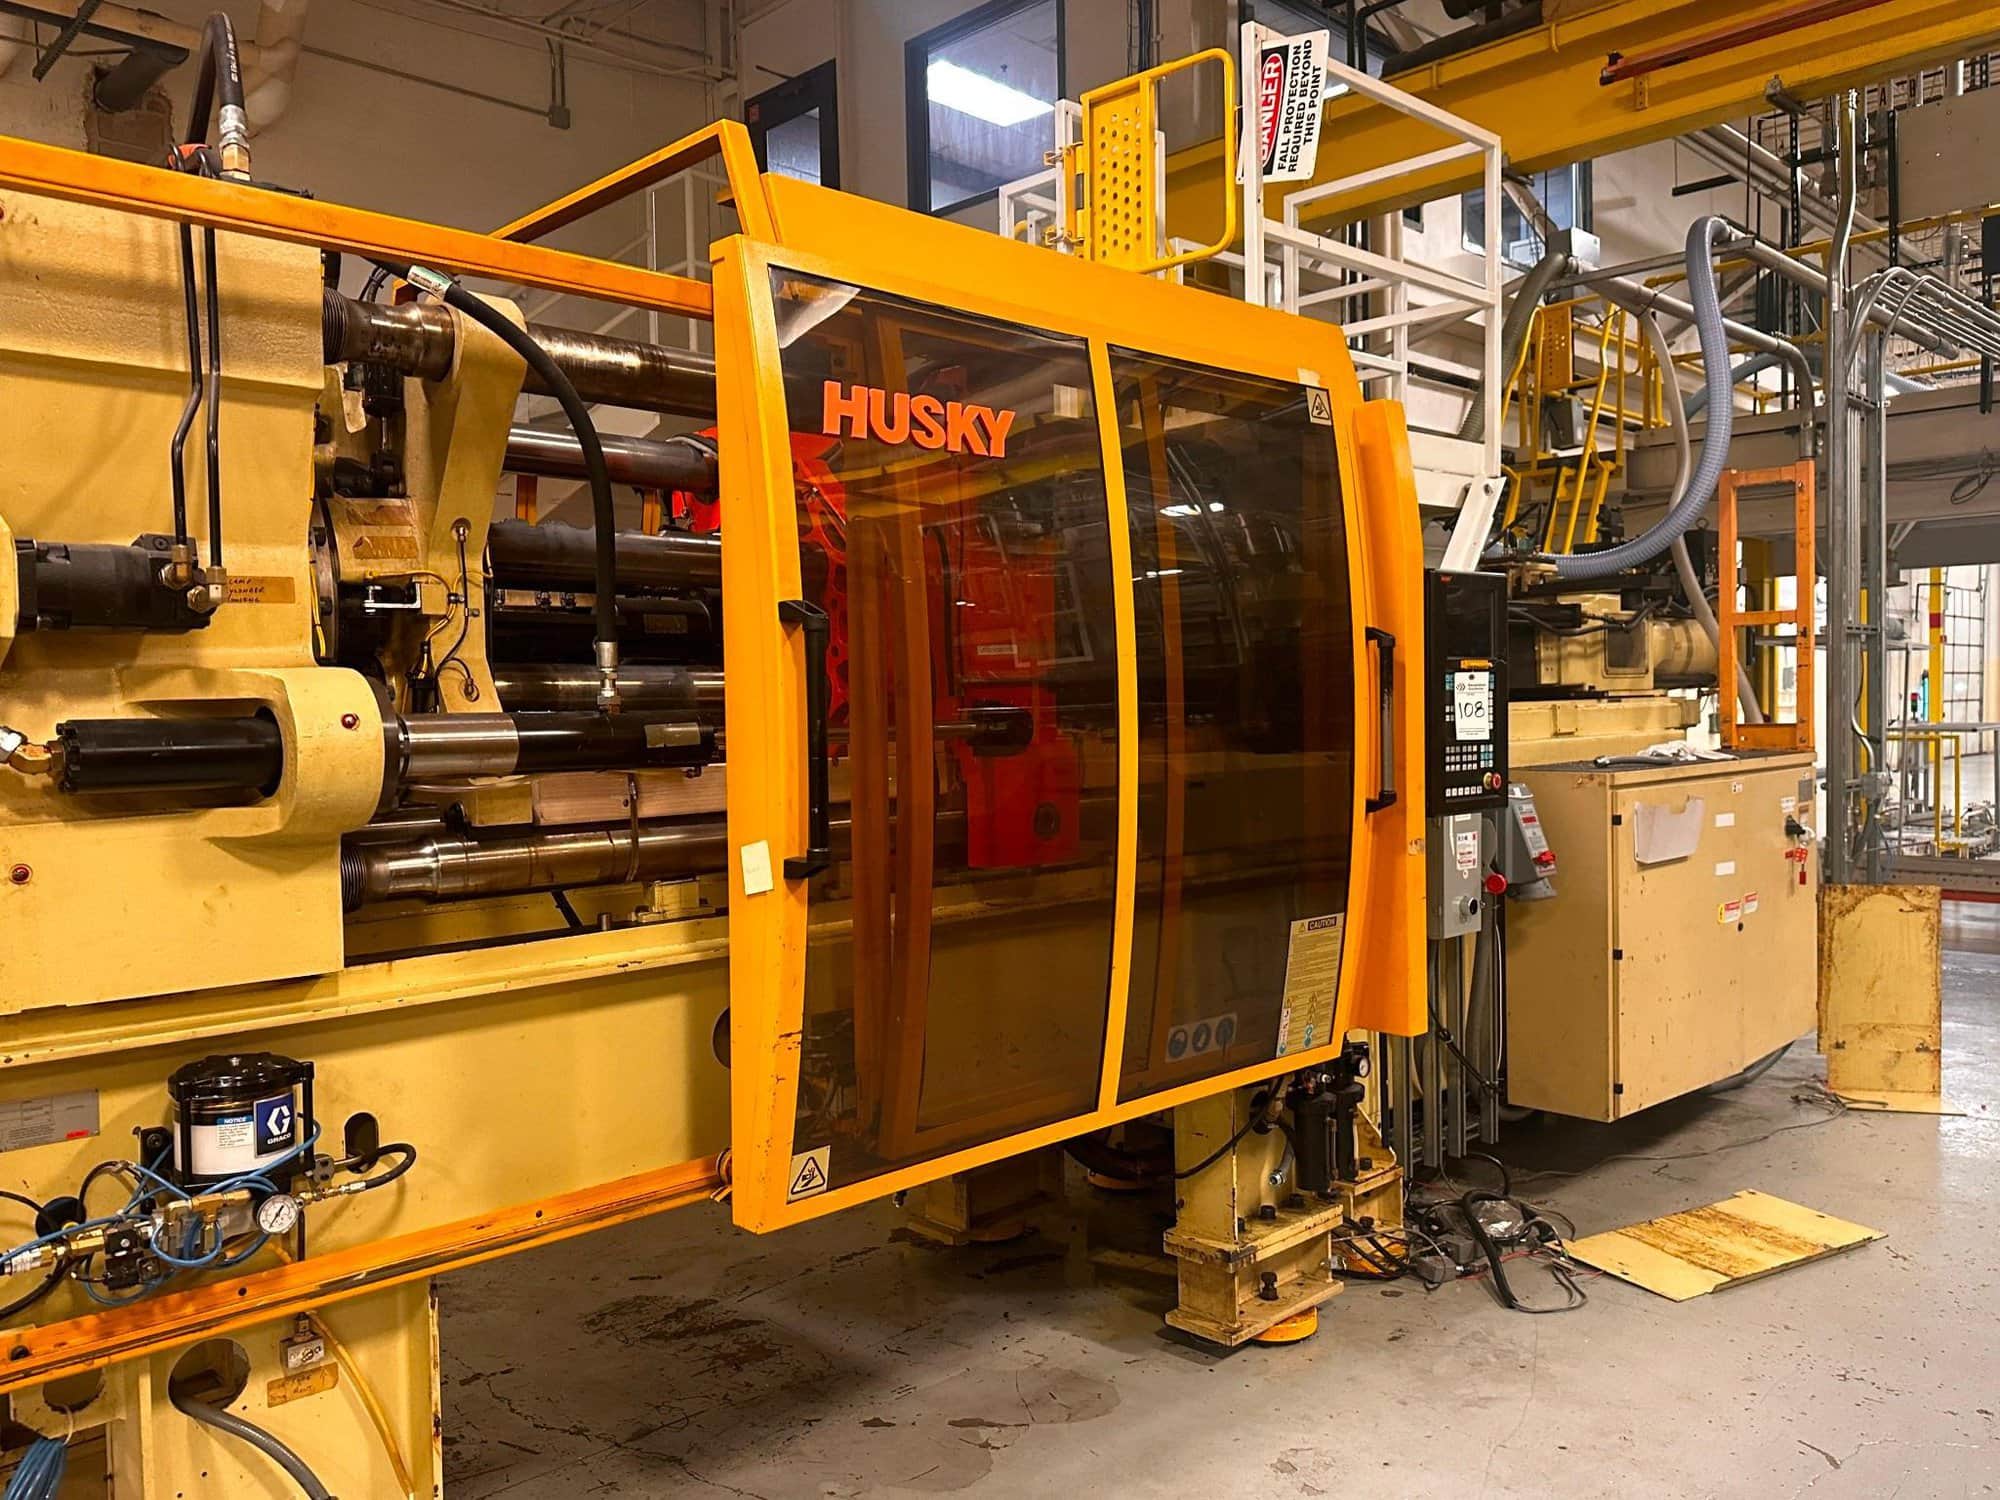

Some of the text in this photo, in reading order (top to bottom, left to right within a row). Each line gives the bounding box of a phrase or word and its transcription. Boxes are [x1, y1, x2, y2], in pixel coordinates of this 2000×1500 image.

[1278, 45, 1302, 170] FALL PROTECTION
[1288, 39, 1312, 172] REQUIRED BEYOND
[1303, 65, 1321, 145] THIS POINT
[822, 380, 1016, 459] HUSKY
[1458, 700, 1486, 720] 108
[1309, 918, 1336, 929] CAUTION
[223, 1116, 246, 1125] NOTICE
[267, 1132, 292, 1144] GRACO
